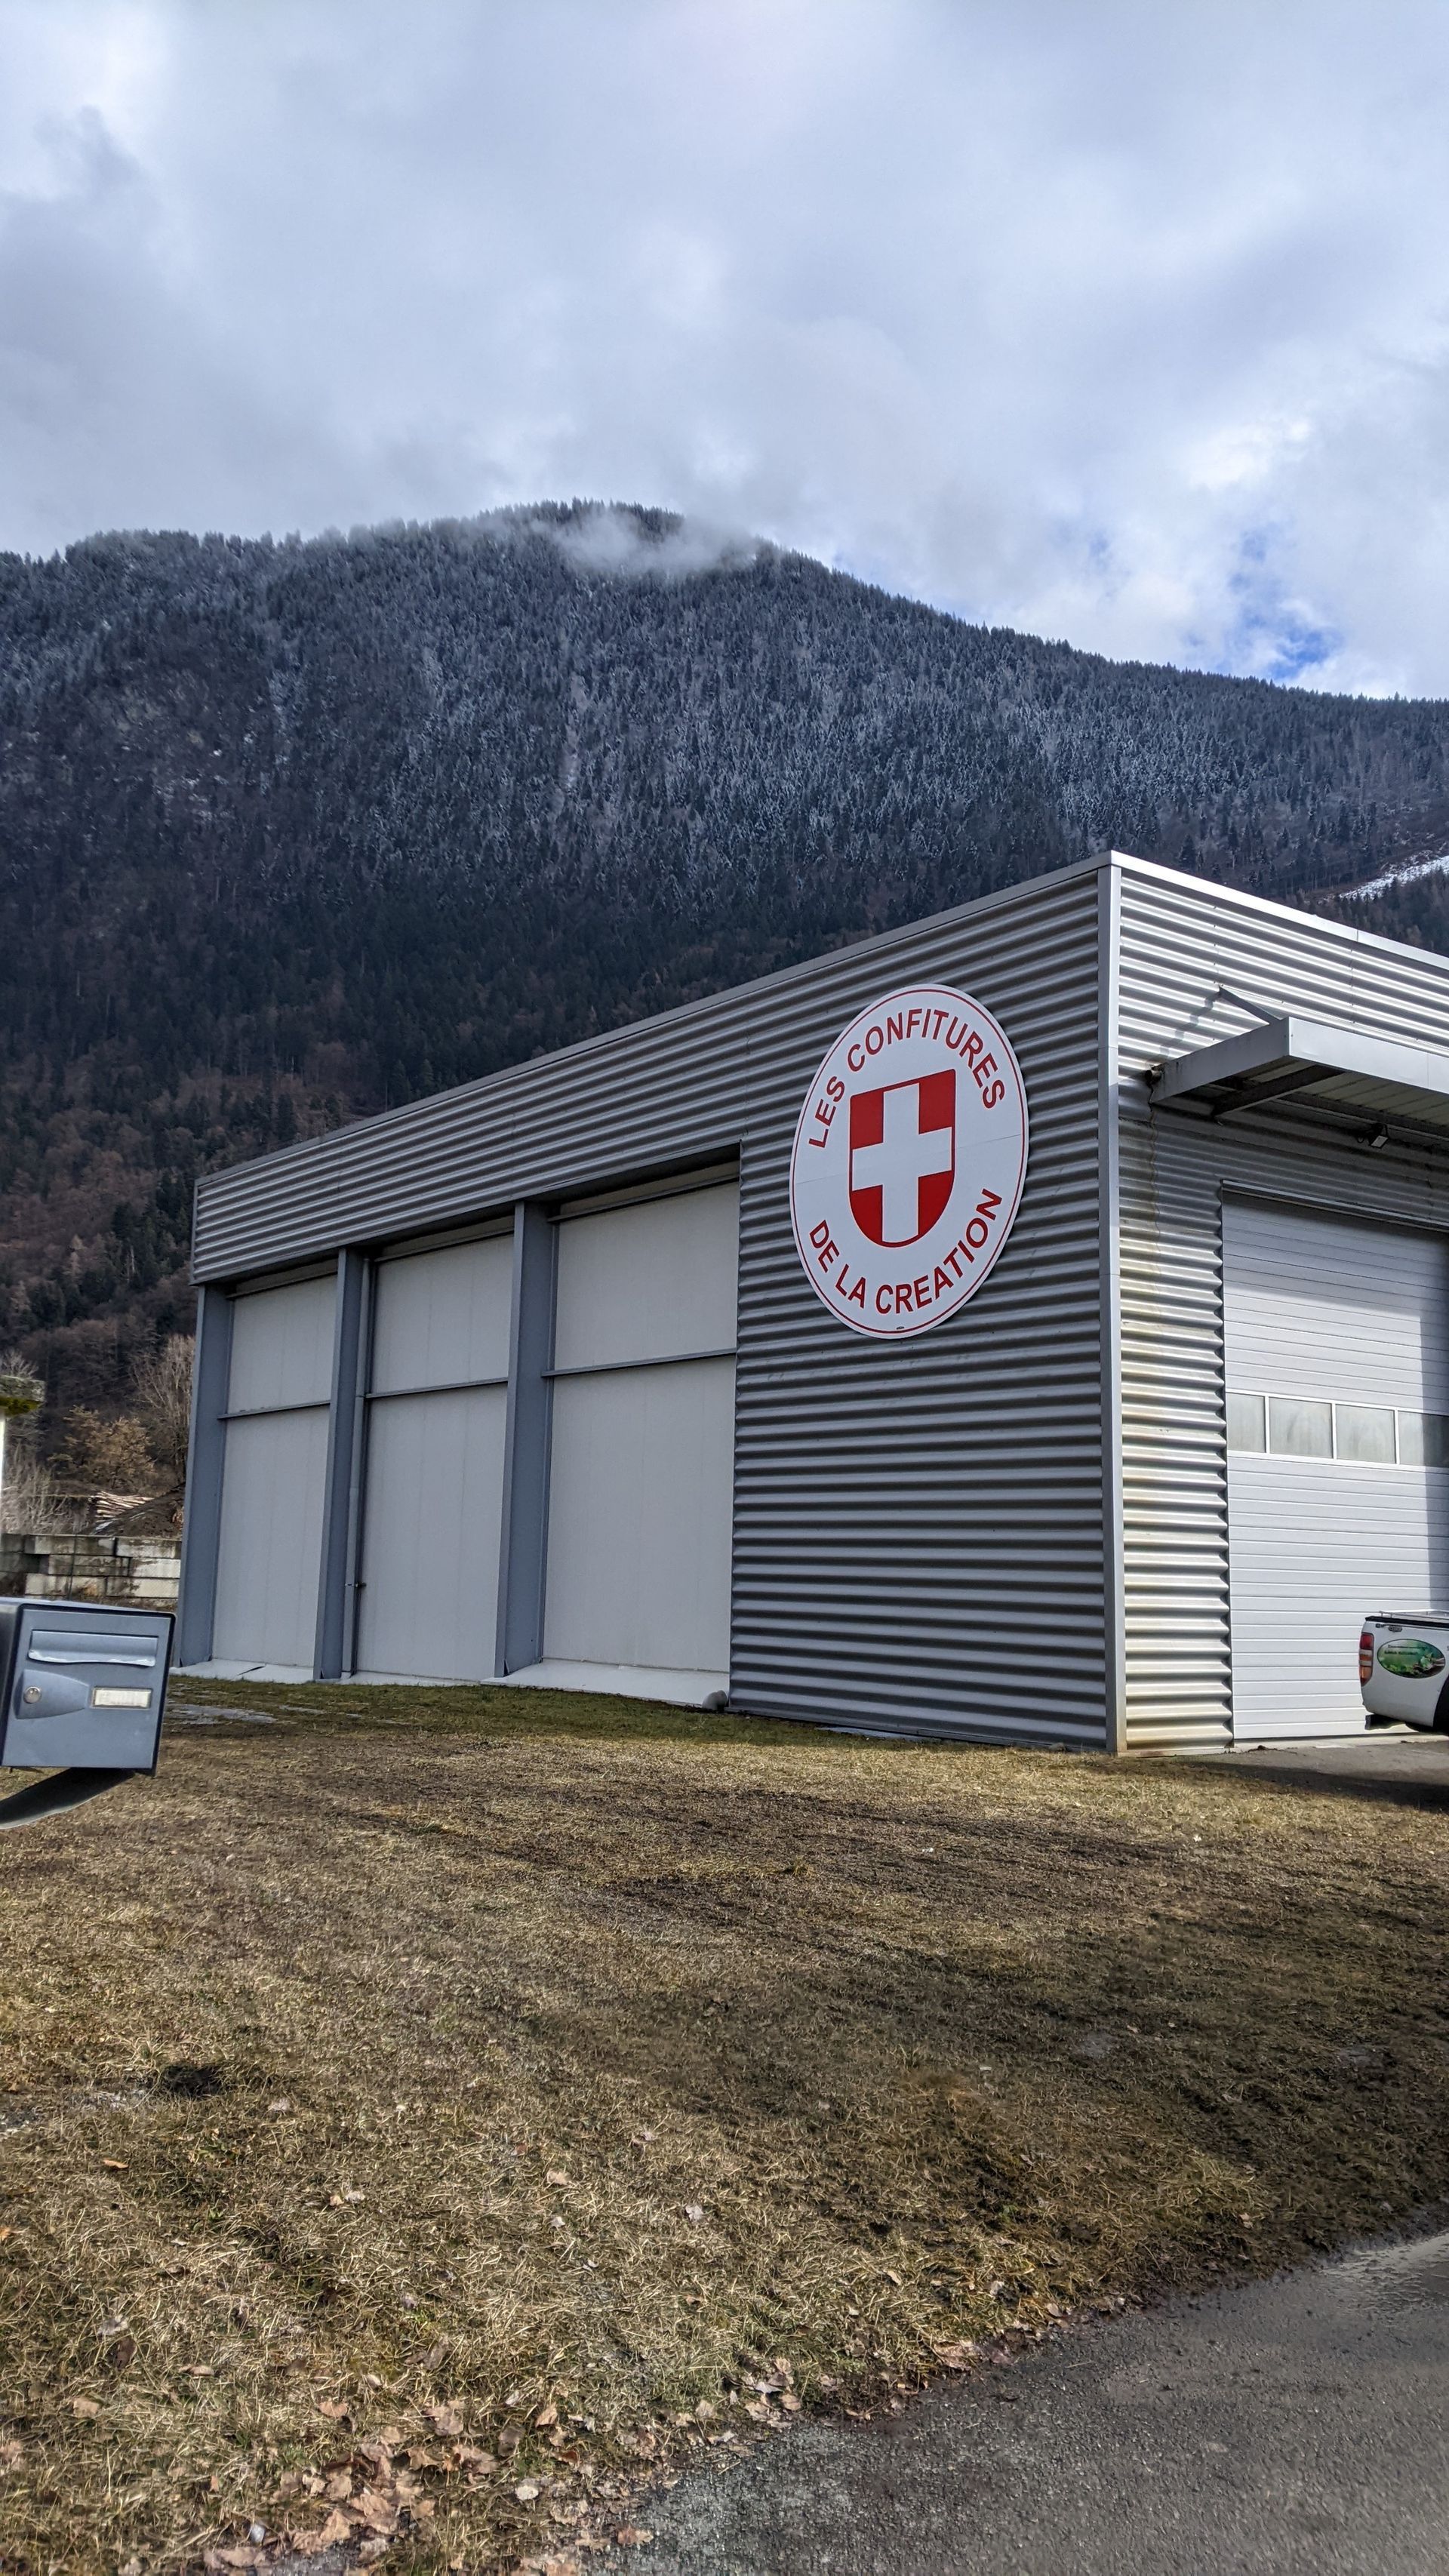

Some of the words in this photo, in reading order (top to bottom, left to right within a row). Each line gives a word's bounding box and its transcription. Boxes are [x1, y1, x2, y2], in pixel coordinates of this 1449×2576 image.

[808, 1076, 845, 1148] LES
[848, 1008, 1005, 1109] CONFITURES
[810, 1220, 840, 1273] DE
[835, 1264, 866, 1309] LA
[876, 1189, 1003, 1315] CREATION
